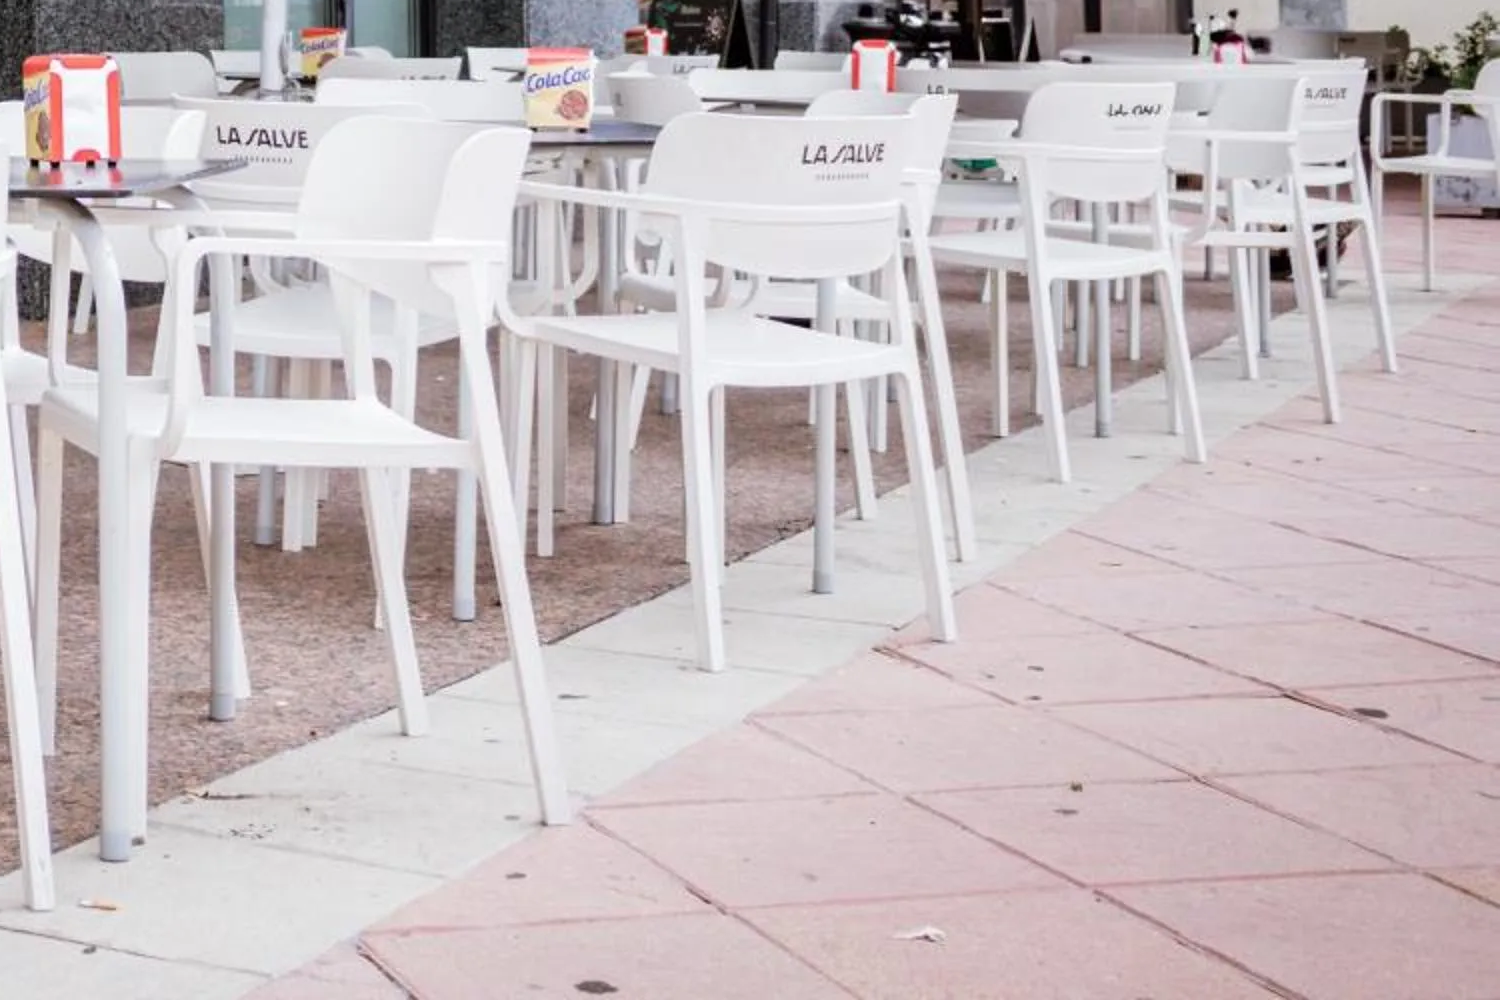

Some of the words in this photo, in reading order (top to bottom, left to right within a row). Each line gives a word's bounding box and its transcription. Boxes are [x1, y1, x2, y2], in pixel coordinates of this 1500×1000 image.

[527, 65, 592, 93] ColaCao
[217, 126, 241, 145] LA
[245, 128, 309, 149] SALVE
[802, 143, 827, 165] LA
[829, 143, 885, 164] SALVE
